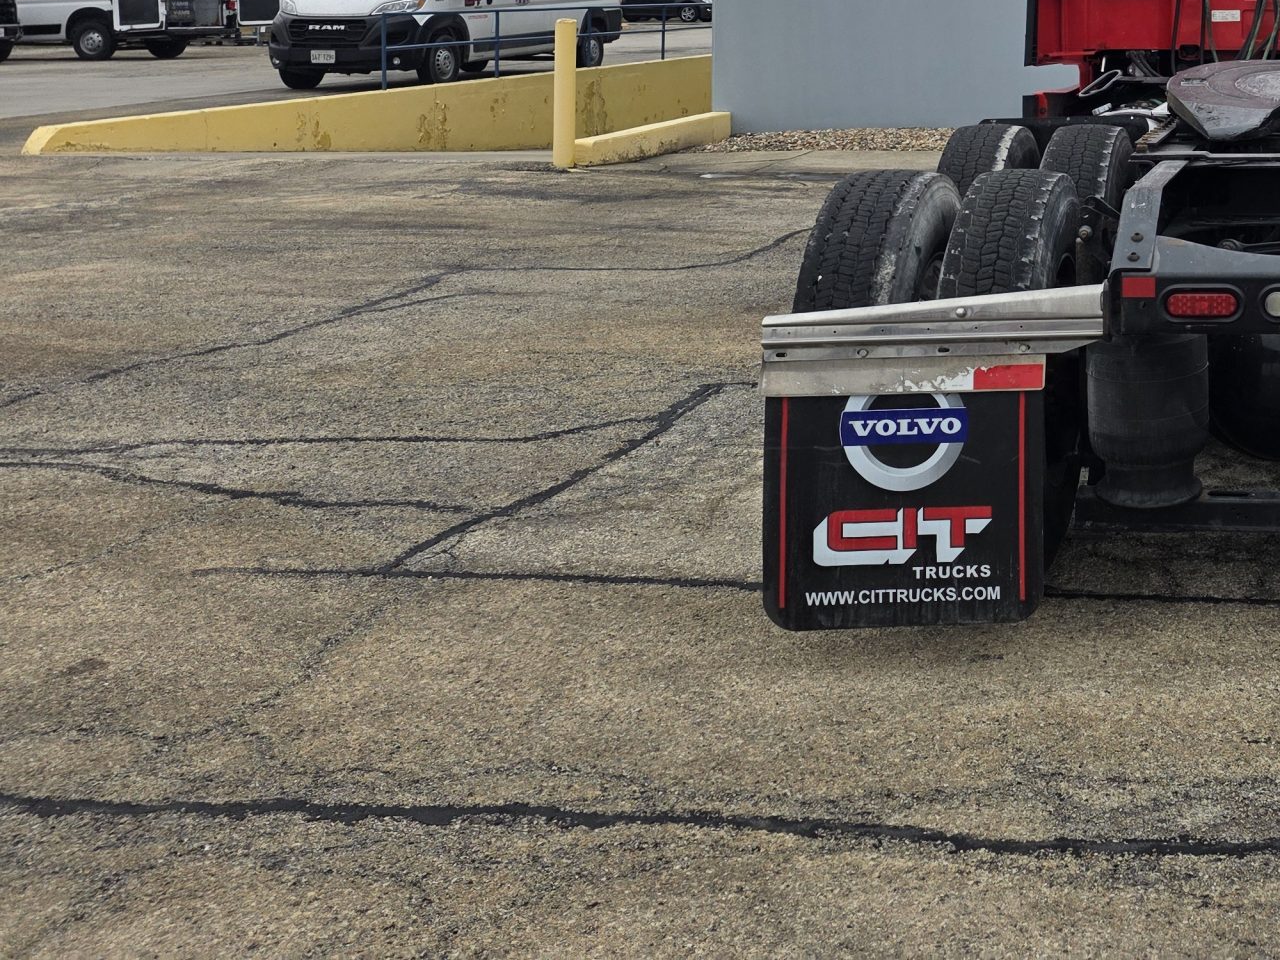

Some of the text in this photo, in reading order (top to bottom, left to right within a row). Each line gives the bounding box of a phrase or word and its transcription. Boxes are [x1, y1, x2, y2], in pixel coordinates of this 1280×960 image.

[849, 417, 962, 437] VOLVO
[813, 505, 993, 567] CIT
[912, 564, 992, 580] TRUCKS
[805, 586, 1001, 607] WWW.CITTRUCKS.COM
